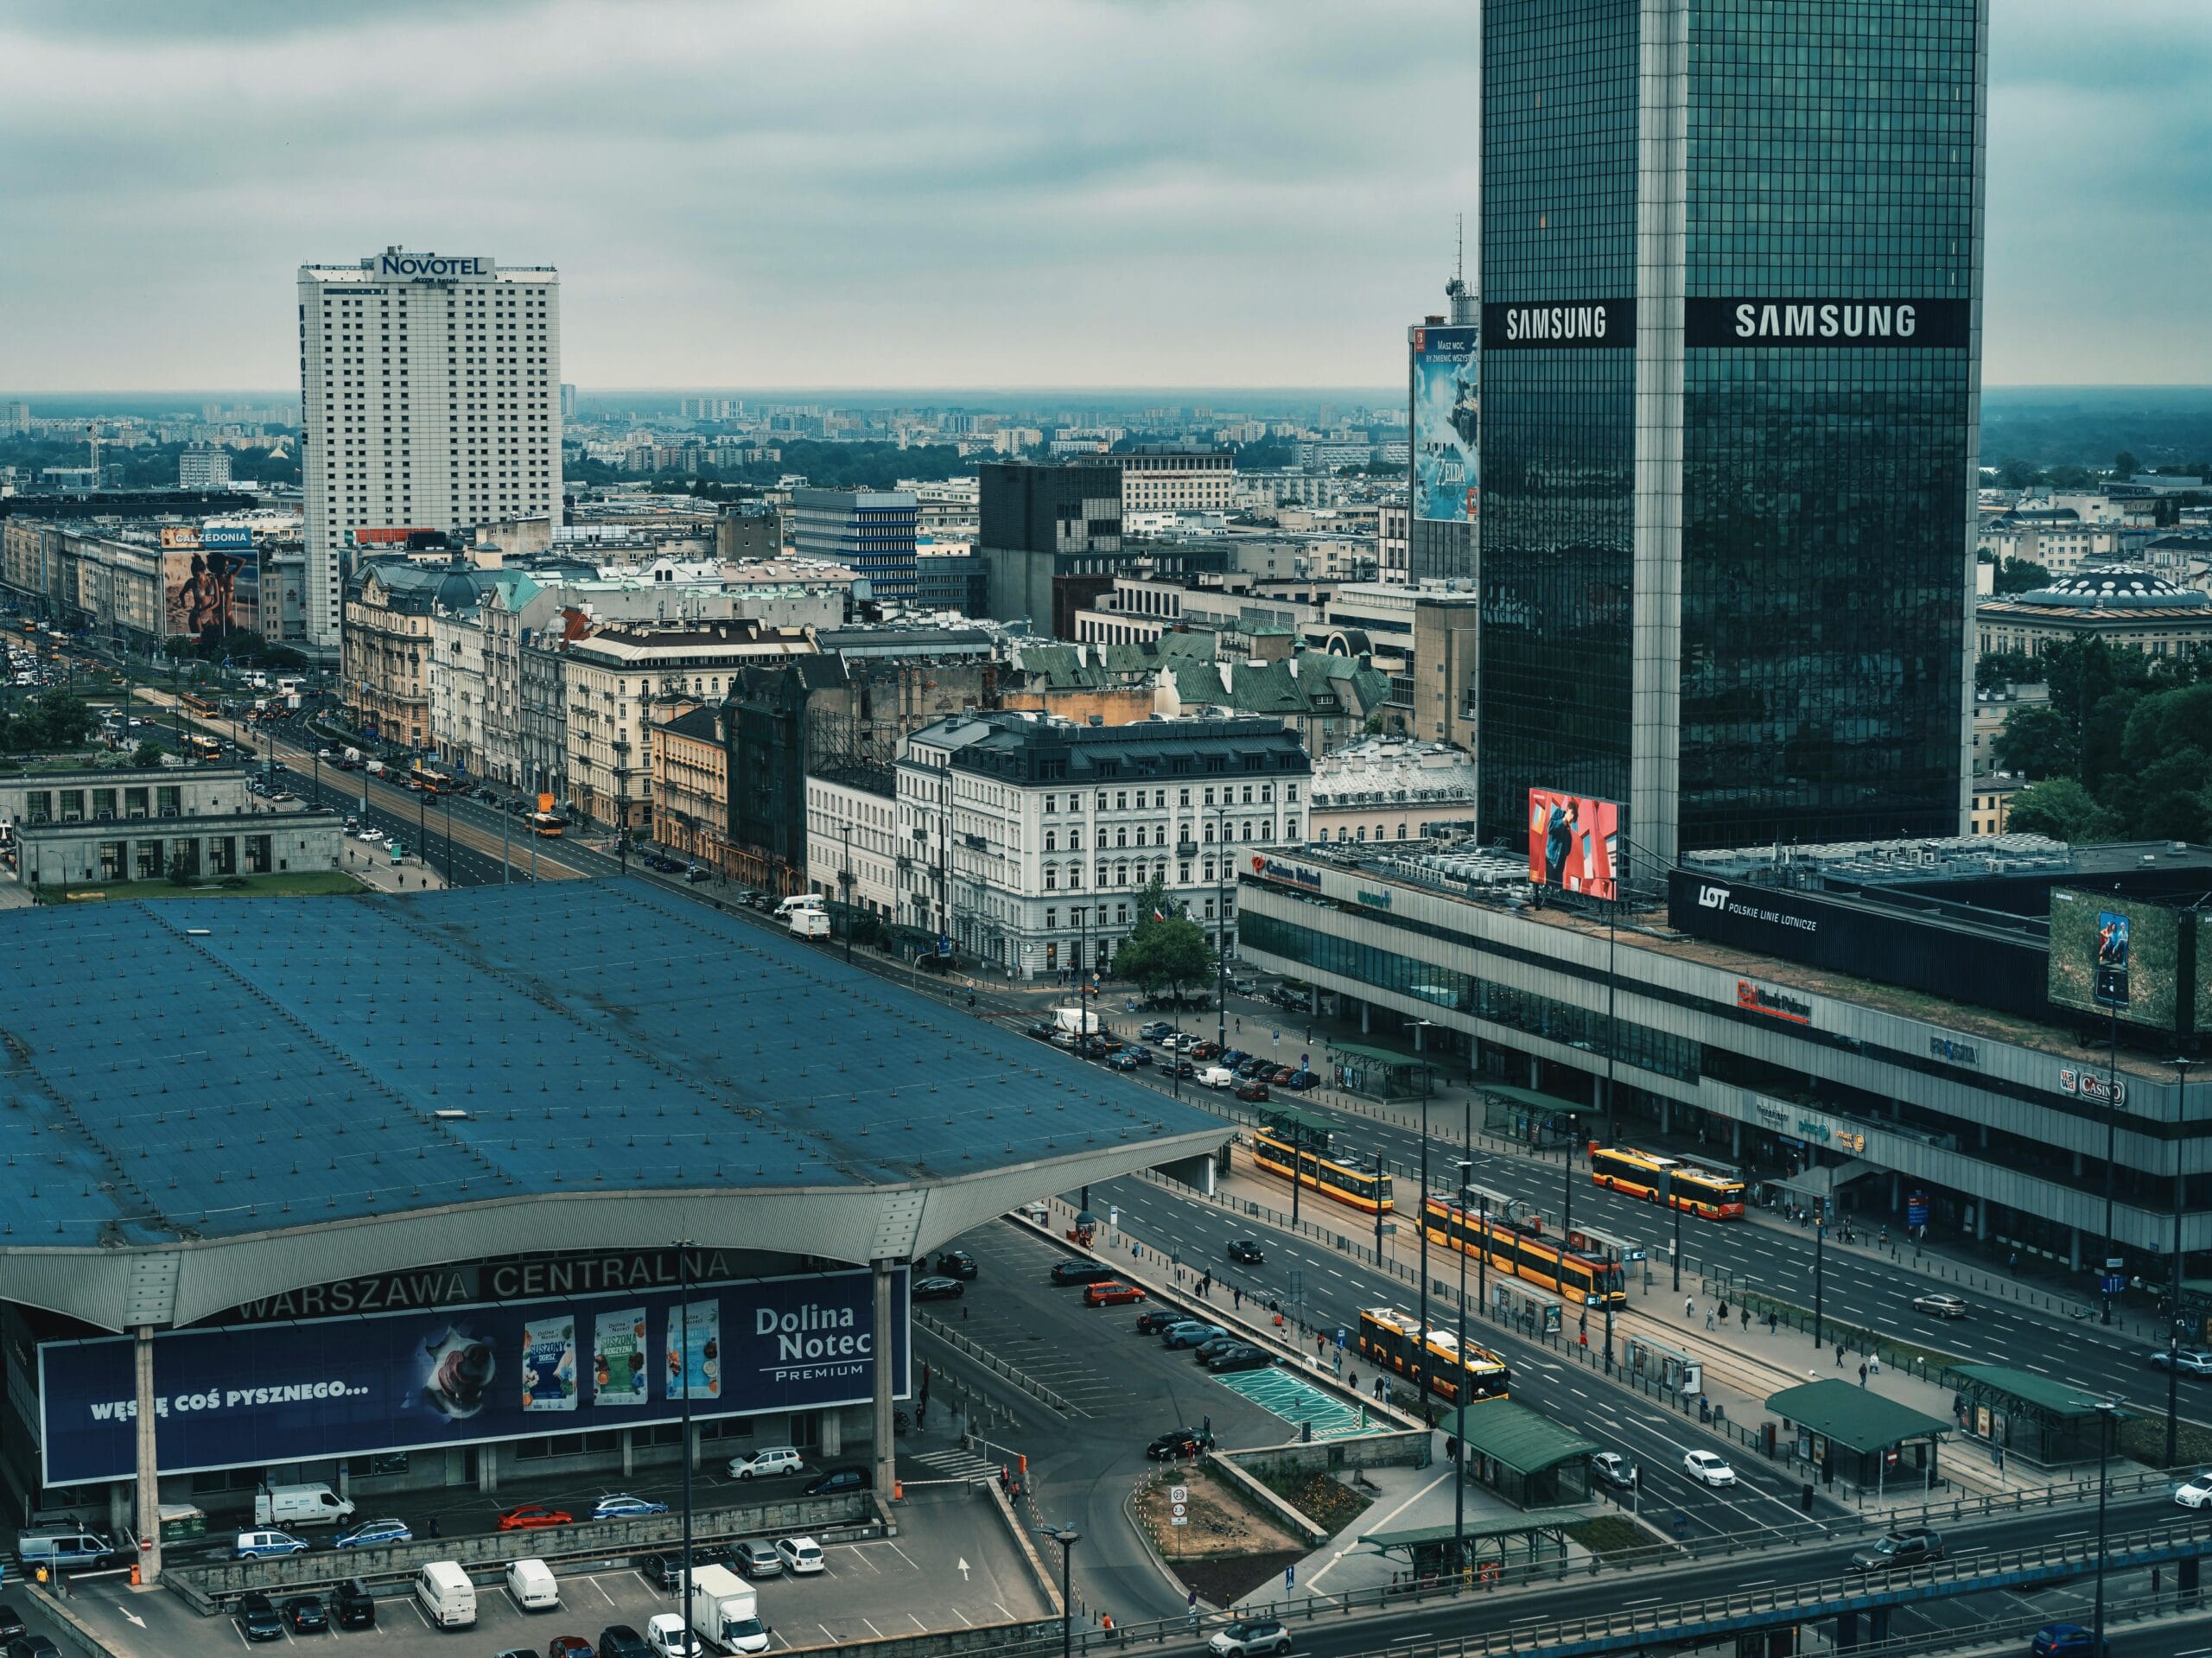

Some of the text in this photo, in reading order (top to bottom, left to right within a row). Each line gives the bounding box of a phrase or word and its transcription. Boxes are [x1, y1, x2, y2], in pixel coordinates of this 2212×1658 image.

[383, 257, 487, 275] NOVOTEL
[1506, 306, 1606, 340] SAMSUNG
[1735, 303, 1916, 338] SAMSUNG
[1435, 458, 1466, 486] ZELDA
[175, 533, 247, 543] CALZEDONIA
[1296, 867, 1321, 887] Poland
[1698, 885, 1817, 931] LOT POLSKIE LINIE LOTNICZE
[2082, 1077, 2121, 1100] CASINO
[239, 1249, 732, 1320] WARSZAWA CENTRALNA
[756, 1304, 855, 1335] Dolina
[530, 1340, 566, 1355] SUSZONY
[601, 1333, 637, 1347] SUSZONA
[778, 1333, 872, 1361] Notec
[538, 1353, 556, 1363] DORSZ
[775, 1365, 863, 1382] PREMIUM
[91, 1381, 369, 1422] WĘSĘ COŚ PYSZNEGO...
